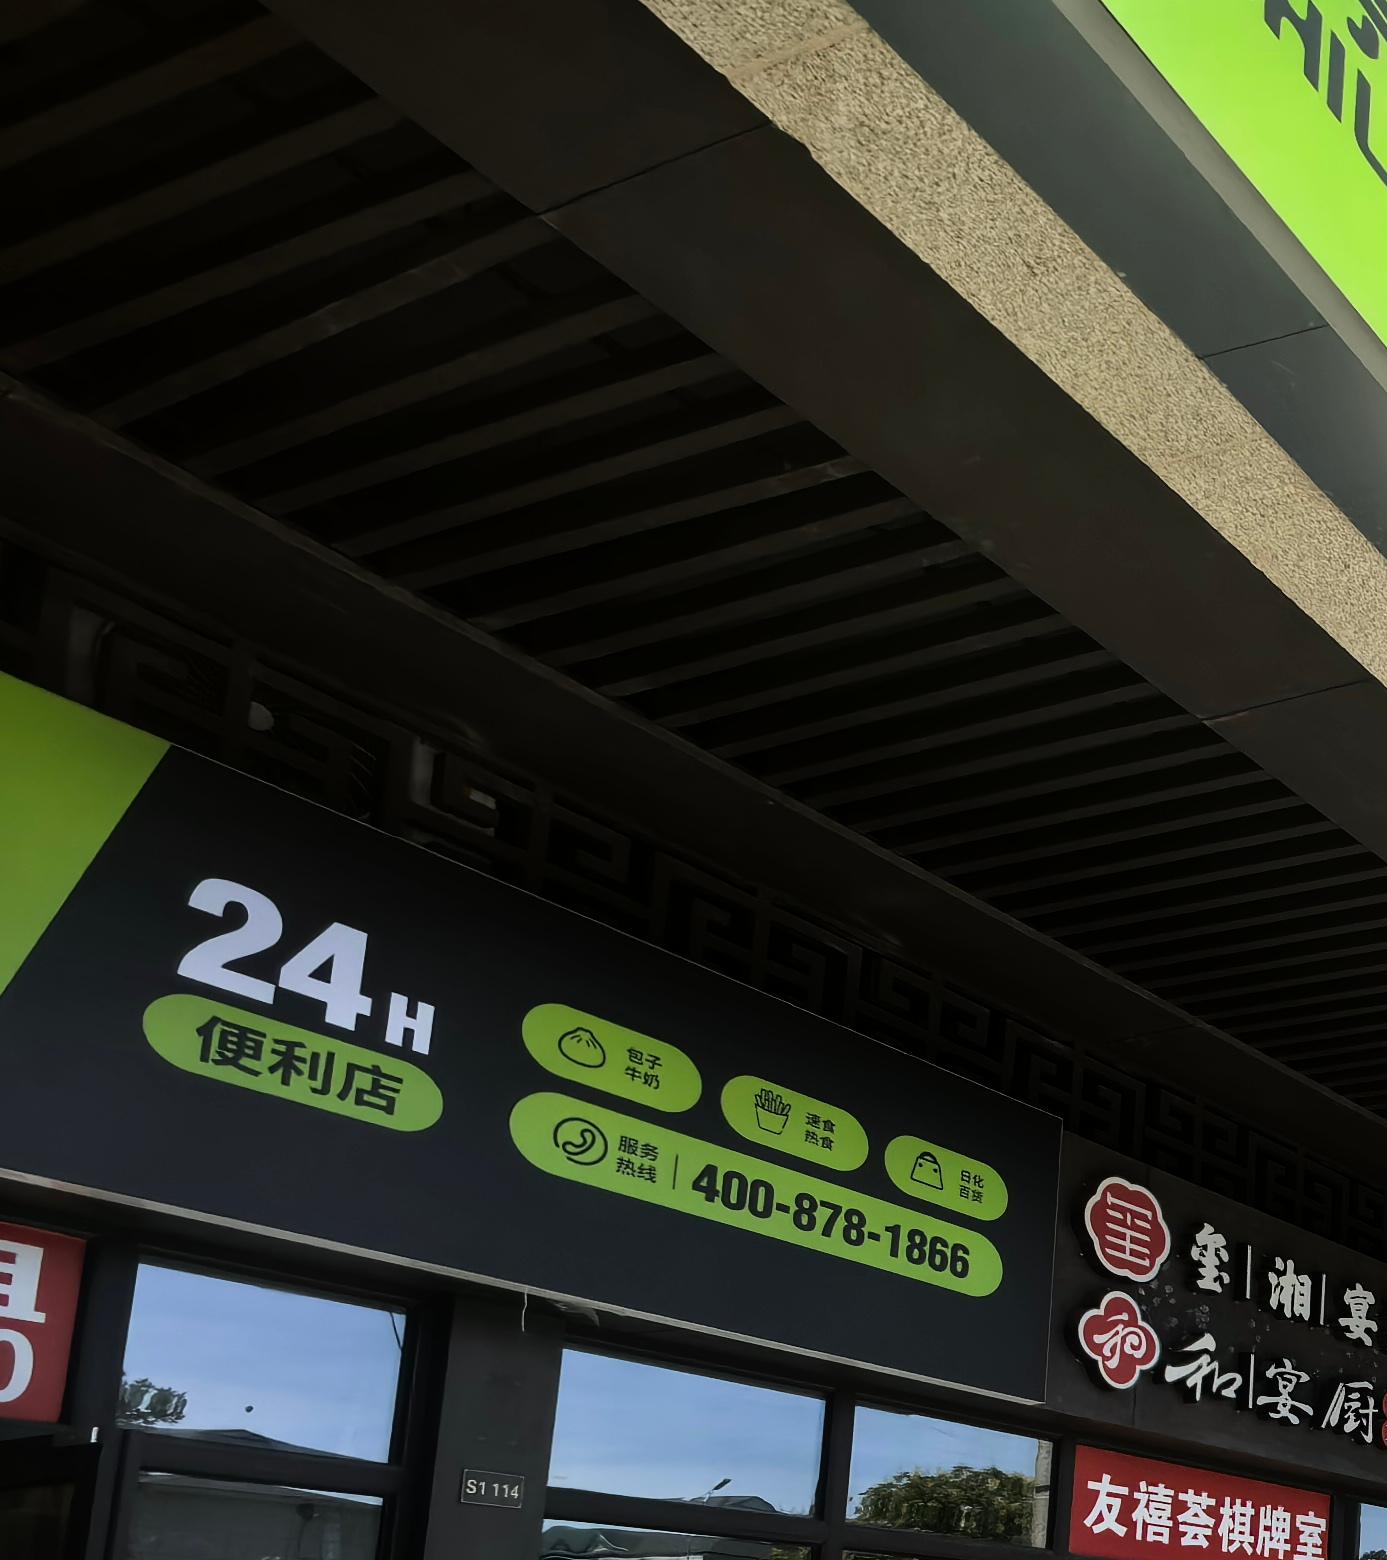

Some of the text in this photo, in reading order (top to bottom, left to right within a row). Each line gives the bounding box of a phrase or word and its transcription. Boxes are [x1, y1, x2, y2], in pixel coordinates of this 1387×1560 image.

[196, 1014, 404, 1117] 便利店
[626, 1045, 663, 1071] 包子
[624, 1067, 660, 1090] 牛奶
[805, 1111, 836, 1135] 速食
[617, 1135, 659, 1161] 服务
[804, 1130, 834, 1152] 热食
[615, 1157, 657, 1184] 热线
[959, 1169, 985, 1188] 日化
[958, 1184, 983, 1205] 百货
[692, 1164, 970, 1280] 400-878-1866
[466, 1480, 520, 1500] S1 114
